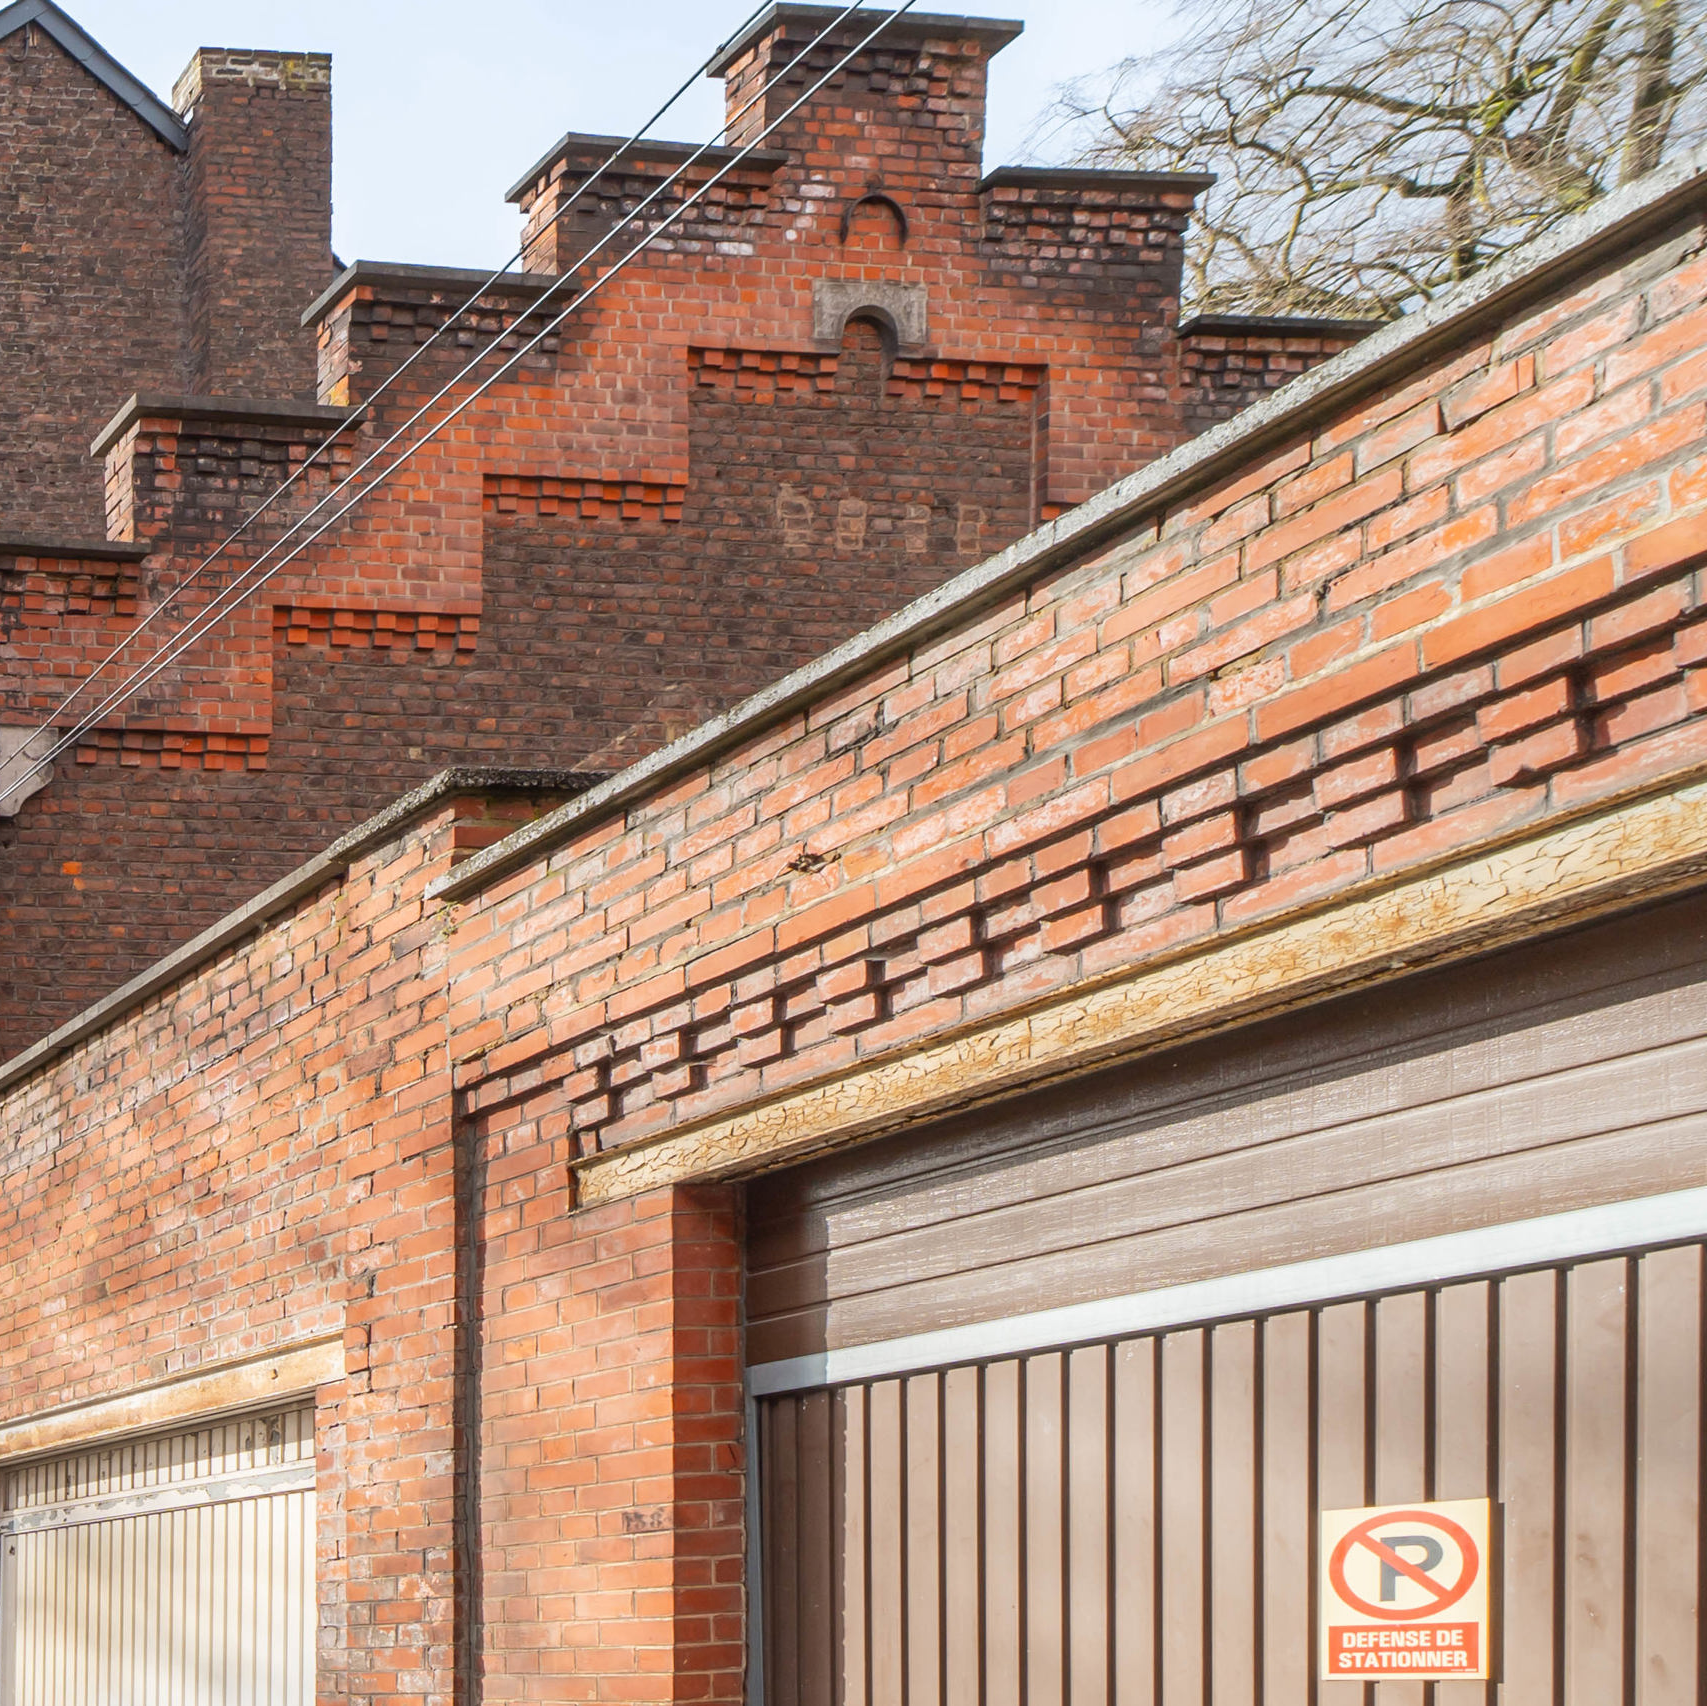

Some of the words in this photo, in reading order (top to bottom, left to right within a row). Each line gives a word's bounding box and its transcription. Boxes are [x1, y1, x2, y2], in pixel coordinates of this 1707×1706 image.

[1379, 1535, 1444, 1602] P
[1342, 1630, 1431, 1649] DEFENSE
[1436, 1628, 1464, 1647] DE
[1338, 1650, 1468, 1669] STATIONNER
